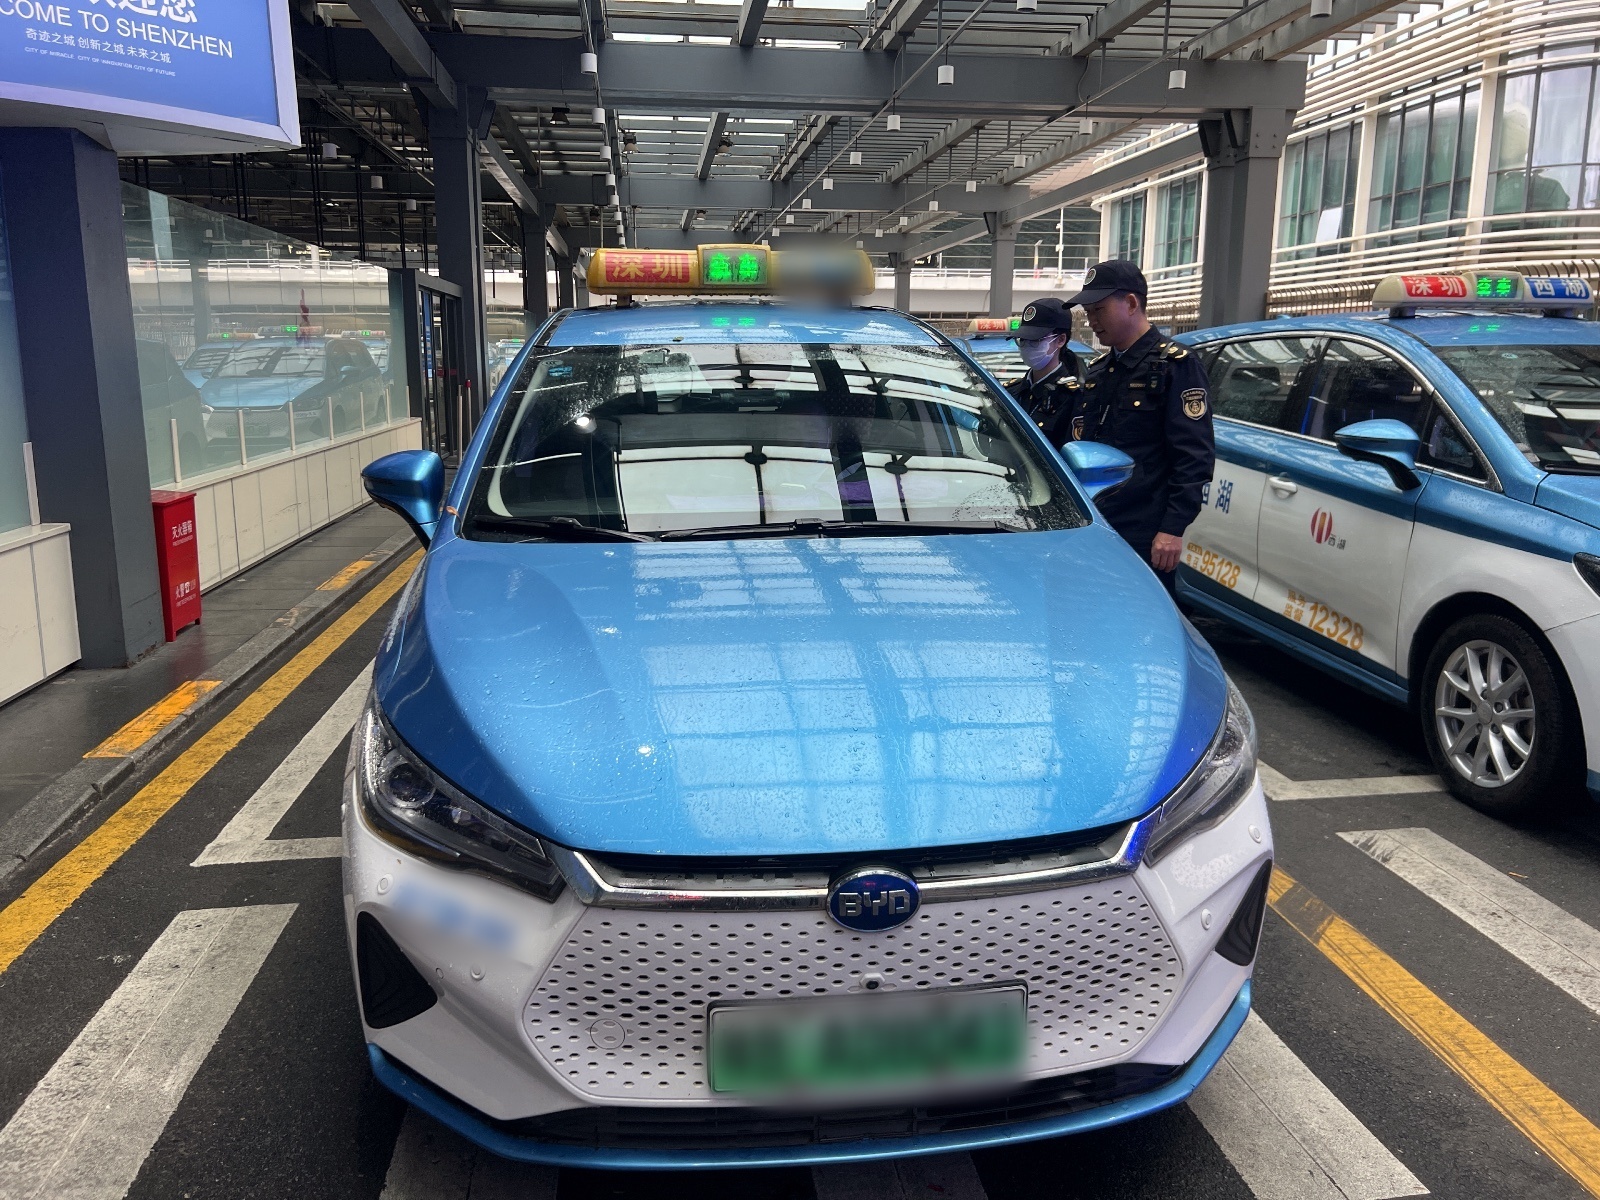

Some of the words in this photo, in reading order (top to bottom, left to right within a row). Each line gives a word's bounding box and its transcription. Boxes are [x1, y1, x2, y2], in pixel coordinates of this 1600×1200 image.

[25, 28, 76, 46] 奇迹之城
[78, 37, 126, 55] 创新之城
[127, 45, 172, 64] 未来之城
[77, 9, 110, 33] TO
[116, 18, 233, 59] SHENZHEN
[612, 253, 683, 280] 深圳
[1406, 276, 1463, 296] 深圳
[1529, 278, 1587, 297] 西湖
[979, 319, 1004, 330] 深圳
[1200, 549, 1241, 589] 95128
[1308, 601, 1364, 650] 12328
[838, 889, 911, 917] BYD
